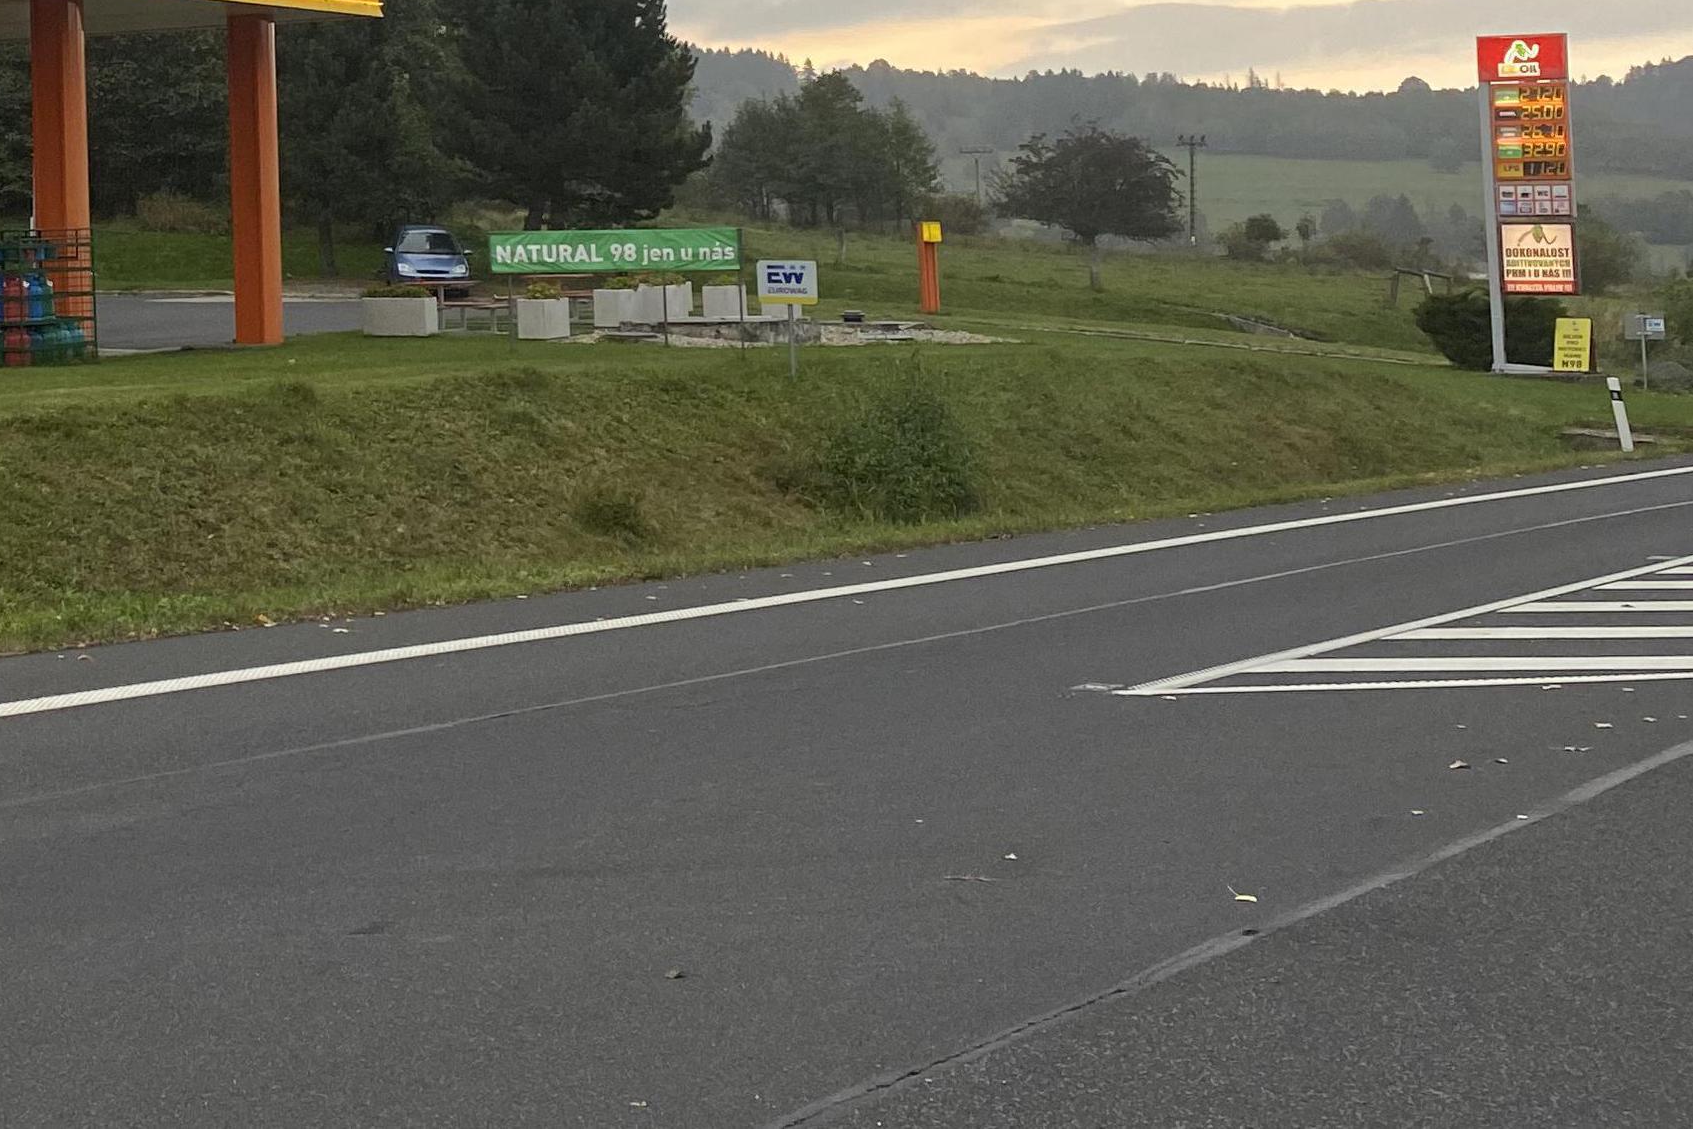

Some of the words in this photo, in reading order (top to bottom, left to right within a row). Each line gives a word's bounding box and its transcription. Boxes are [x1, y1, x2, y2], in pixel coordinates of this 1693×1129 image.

[495, 243, 604, 264] NATURAL
[610, 243, 637, 263] 98
[642, 244, 674, 266] jen
[682, 248, 693, 261] u
[699, 241, 735, 261] nás
